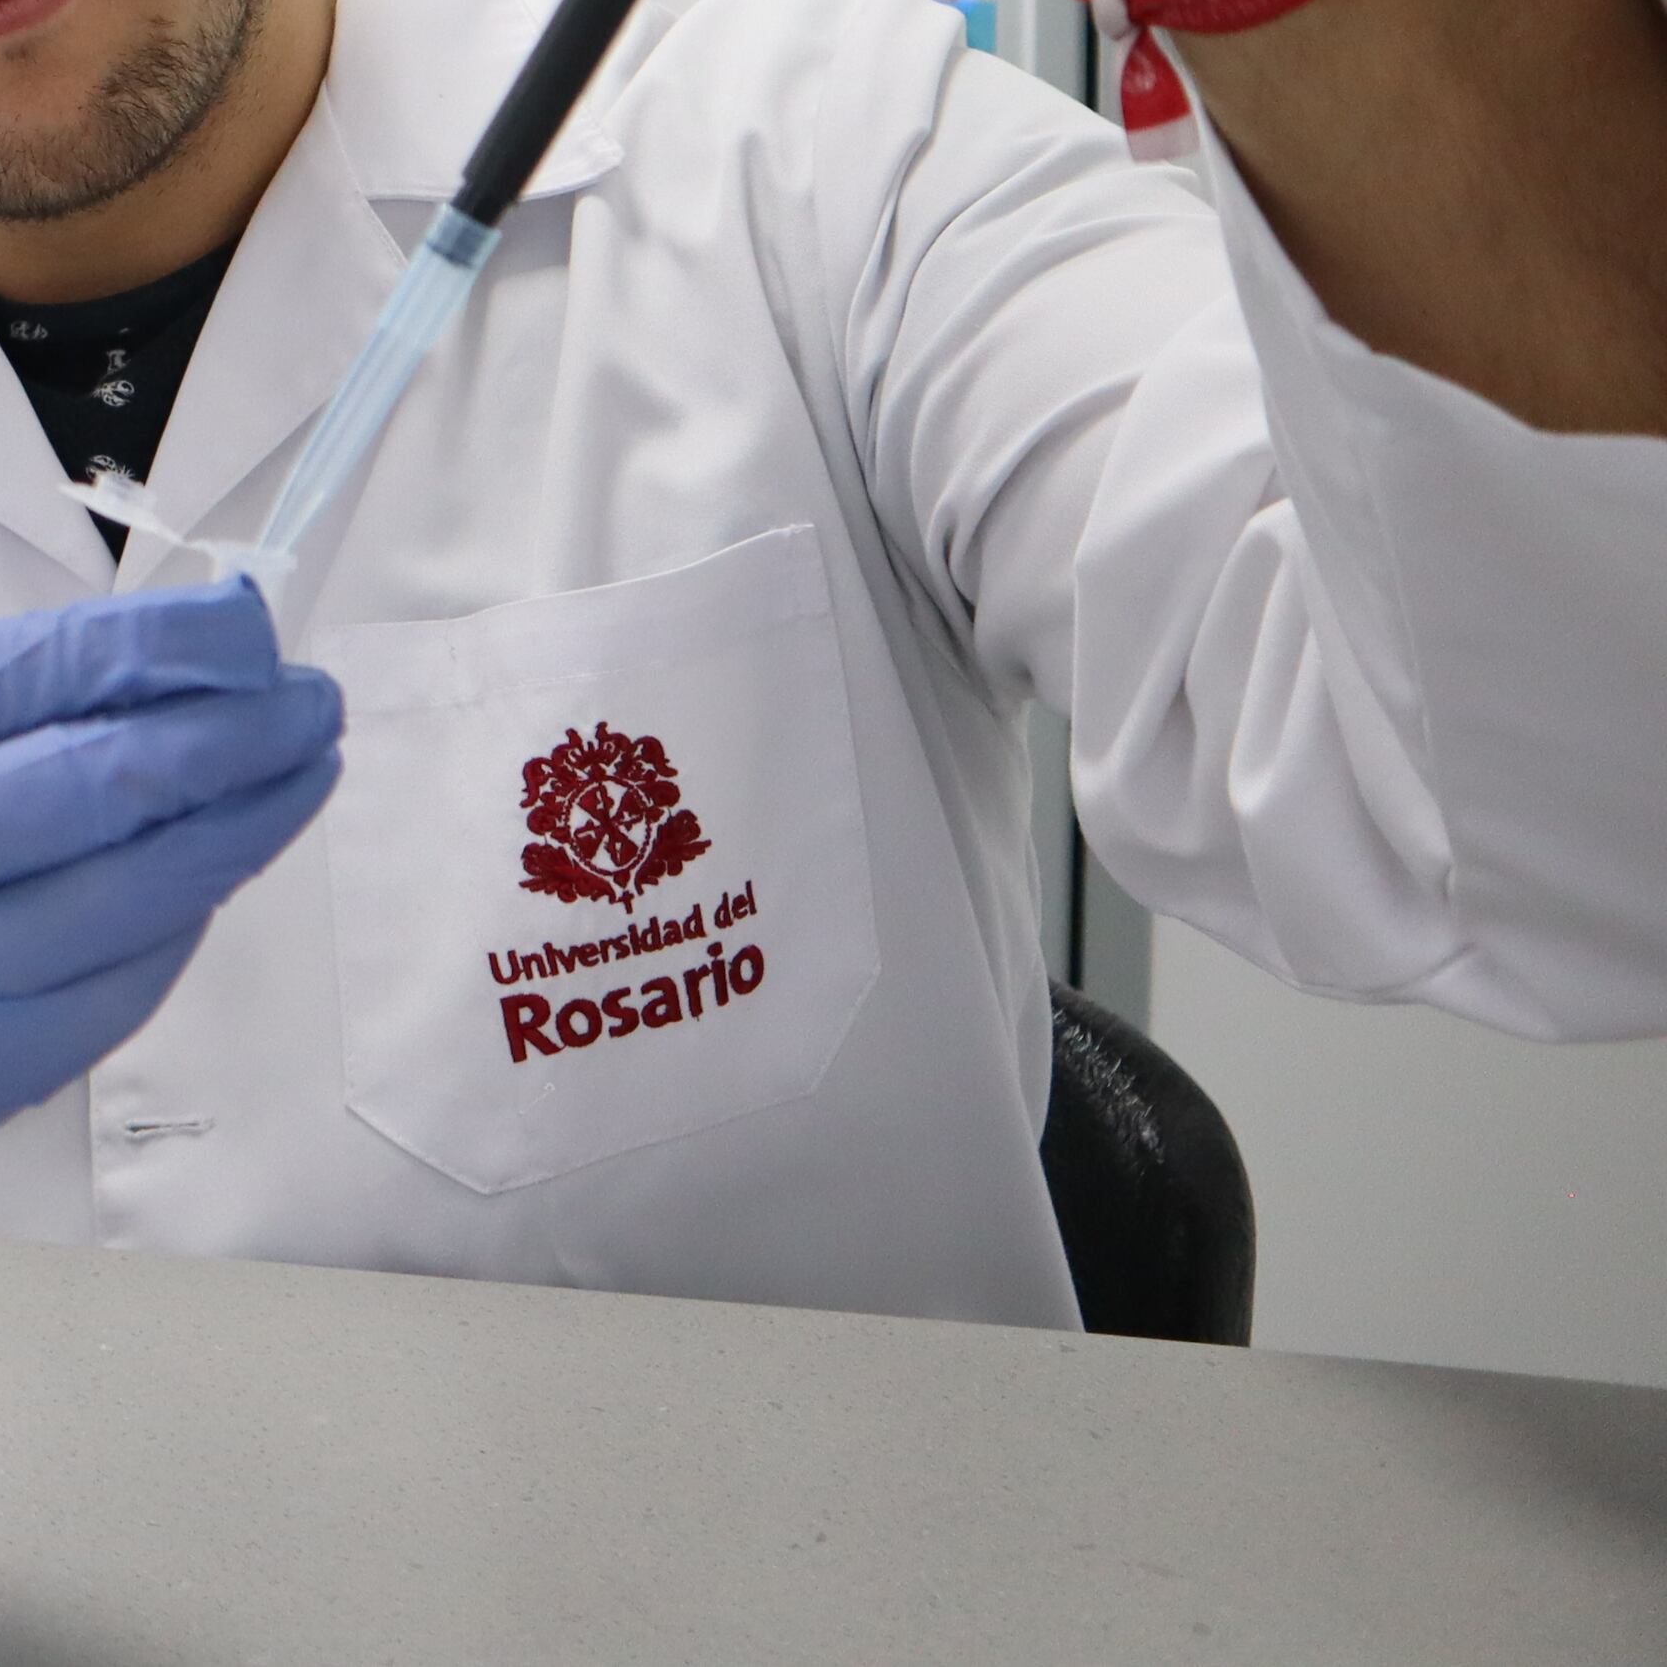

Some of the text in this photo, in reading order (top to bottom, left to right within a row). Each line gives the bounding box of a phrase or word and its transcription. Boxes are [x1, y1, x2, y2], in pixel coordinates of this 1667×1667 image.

[487, 880, 758, 985] Universidad del
[499, 941, 766, 1064] Rosario
